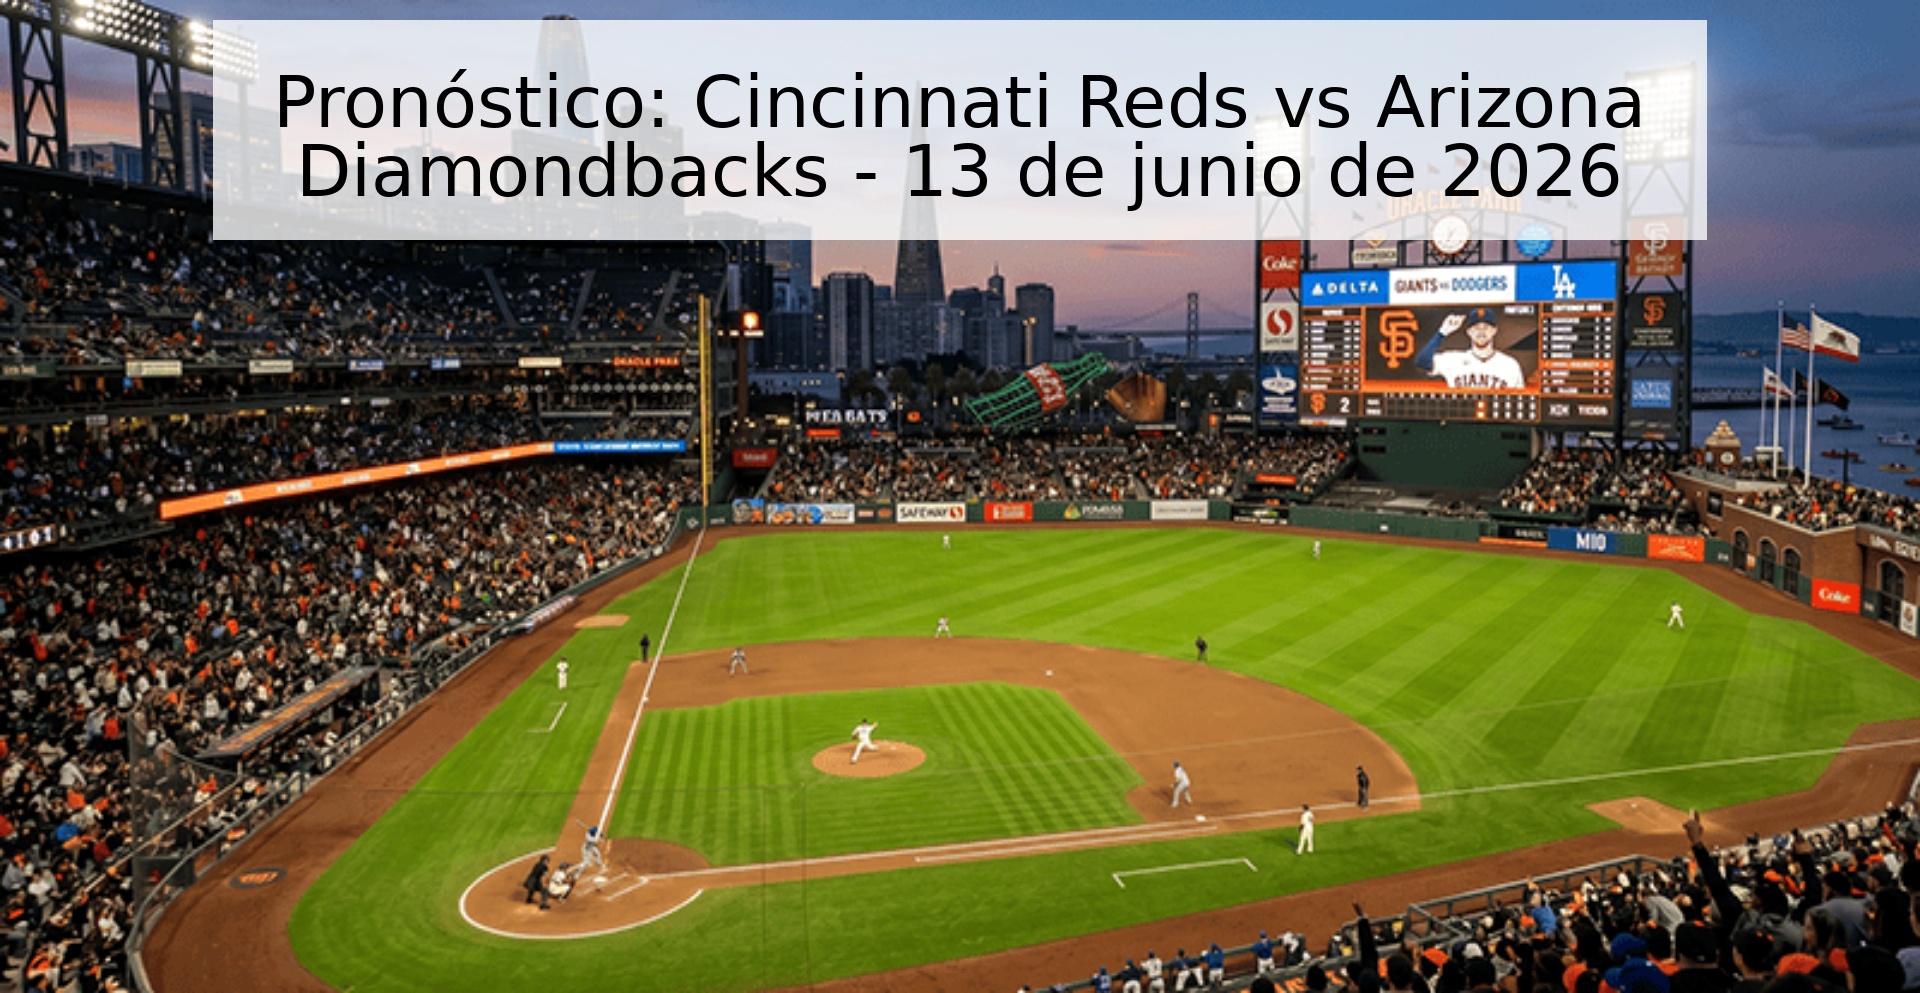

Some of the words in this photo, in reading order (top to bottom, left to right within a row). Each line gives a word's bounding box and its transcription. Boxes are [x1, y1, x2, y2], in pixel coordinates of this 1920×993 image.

[1262, 255, 1297, 271] Coke
[1327, 280, 1379, 294] DELTA
[1394, 278, 1438, 293] GIANTS
[1451, 275, 1508, 291] DODGERS
[1340, 397, 1350, 413] 2
[899, 507, 949, 519] SAFEWAY
